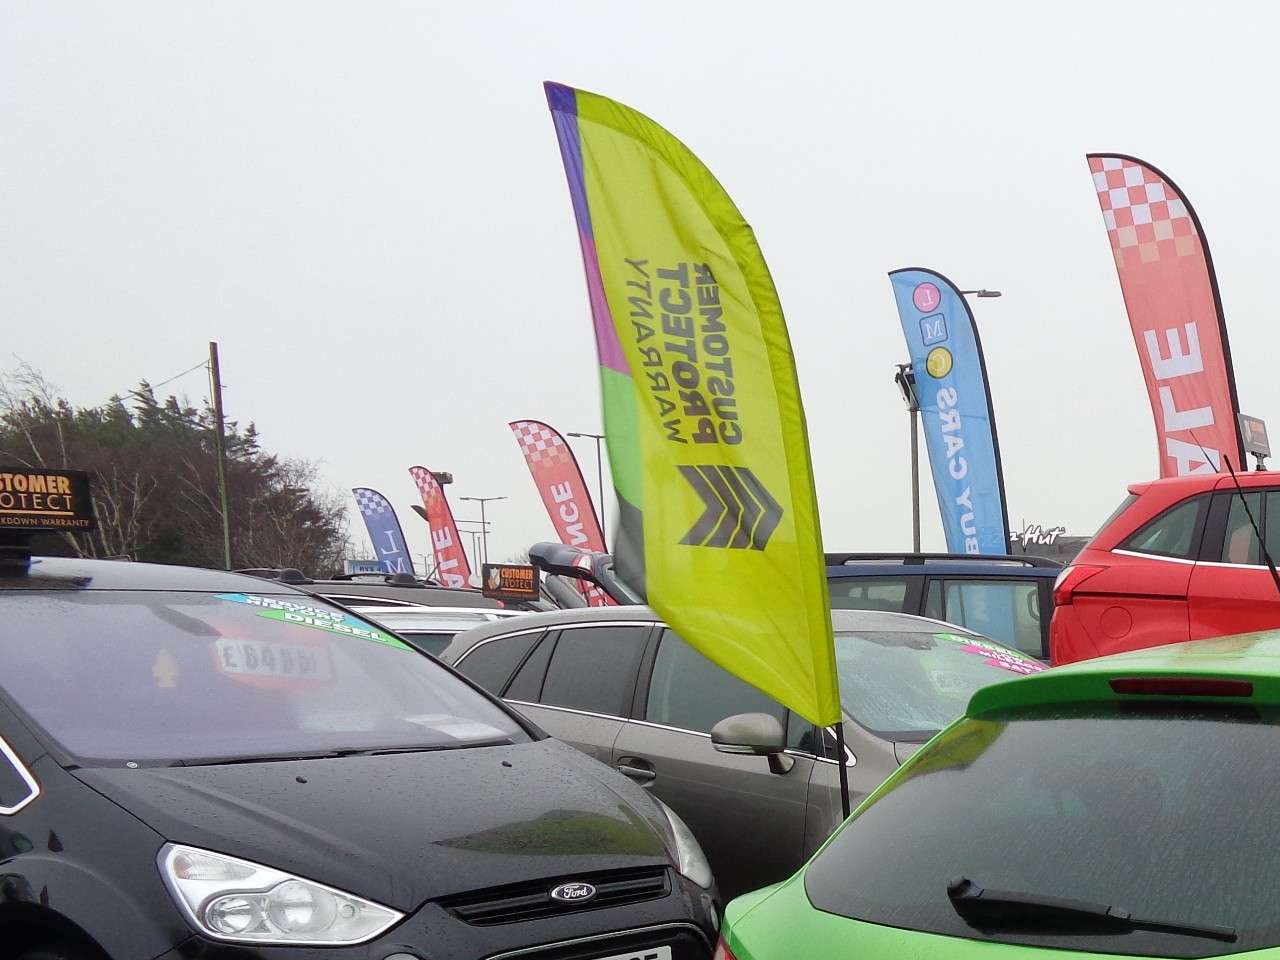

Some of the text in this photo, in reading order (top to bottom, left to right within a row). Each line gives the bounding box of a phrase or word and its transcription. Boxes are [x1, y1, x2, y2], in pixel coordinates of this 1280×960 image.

[501, 567, 534, 580] CUSTOMER
[284, 612, 388, 642] DIESEL
[563, 884, 588, 899] Ford
